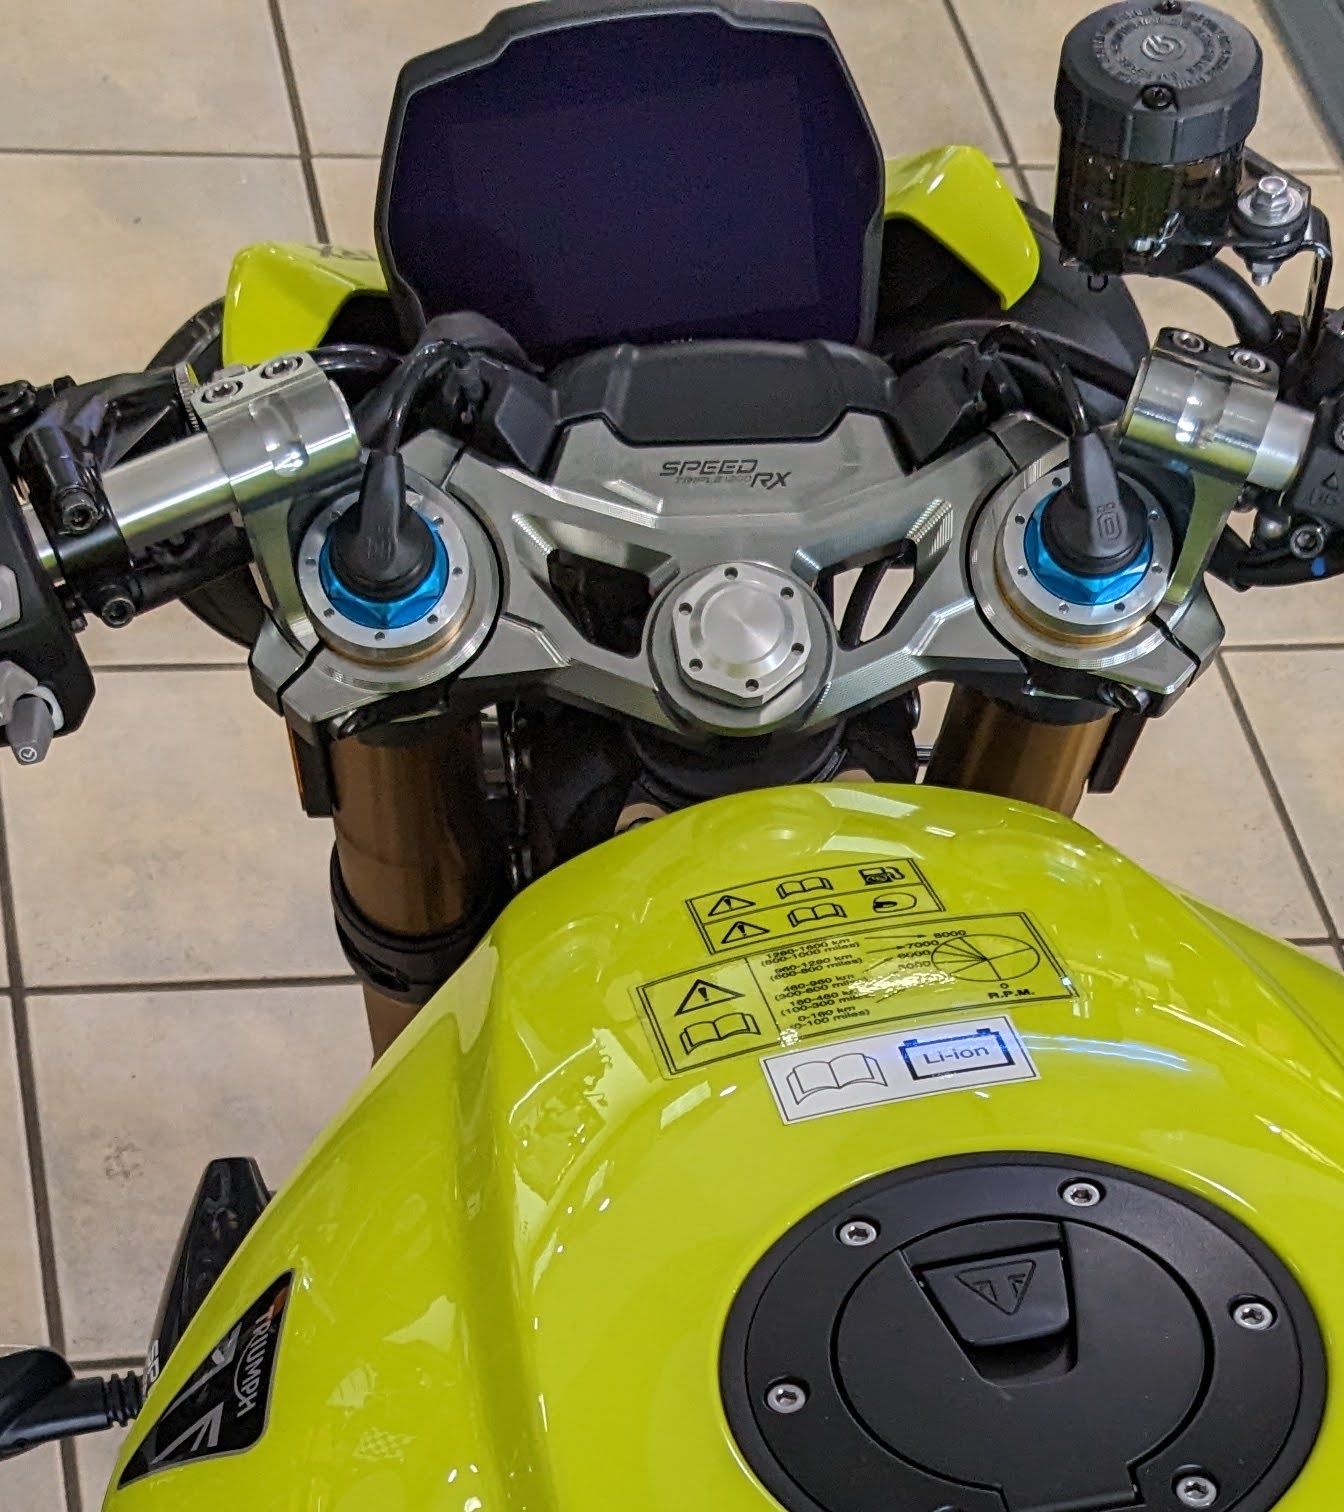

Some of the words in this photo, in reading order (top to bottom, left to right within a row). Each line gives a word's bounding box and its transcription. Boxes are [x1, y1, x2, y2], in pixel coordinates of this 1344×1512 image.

[659, 459, 758, 477] SPEED
[750, 471, 793, 491] RX
[824, 941, 861, 954] miles)
[832, 938, 851, 947] km
[906, 940, 940, 950] 7000
[826, 957, 863, 970] miles)
[833, 954, 853, 963] km
[834, 973, 855, 982] km
[987, 988, 1036, 1000] R.P.M.
[832, 1008, 871, 1022] miles)
[836, 1005, 856, 1014] km
[922, 1045, 990, 1065] Li-ion
[235, 1303, 276, 1418] TRIUMPH
